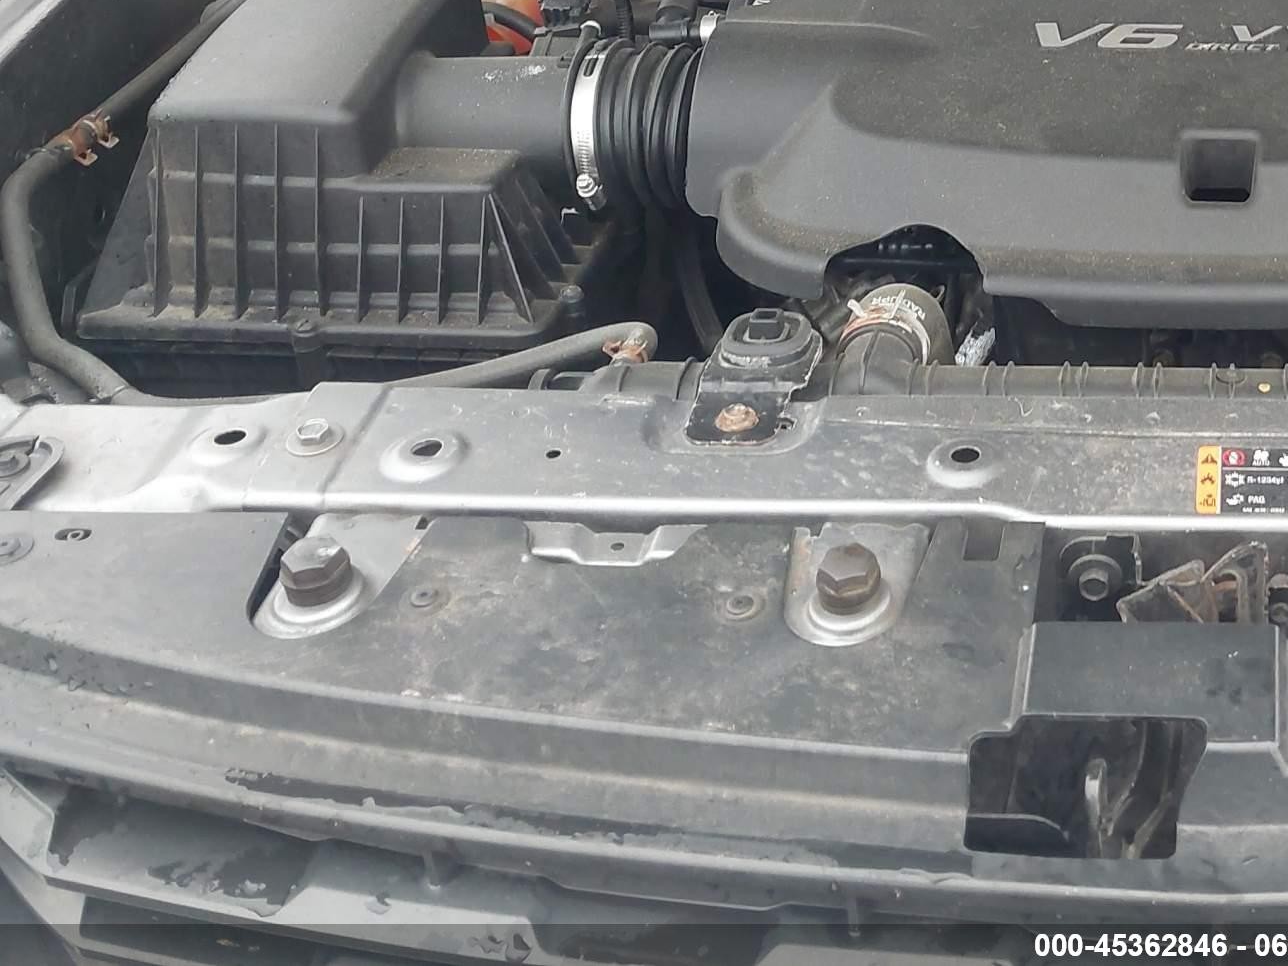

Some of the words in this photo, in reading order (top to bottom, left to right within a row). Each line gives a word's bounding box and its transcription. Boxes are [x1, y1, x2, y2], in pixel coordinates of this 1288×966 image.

[1035, 22, 1184, 49] V6
[1184, 41, 1280, 53] DIRECT
[1248, 495, 1266, 504] PAG
